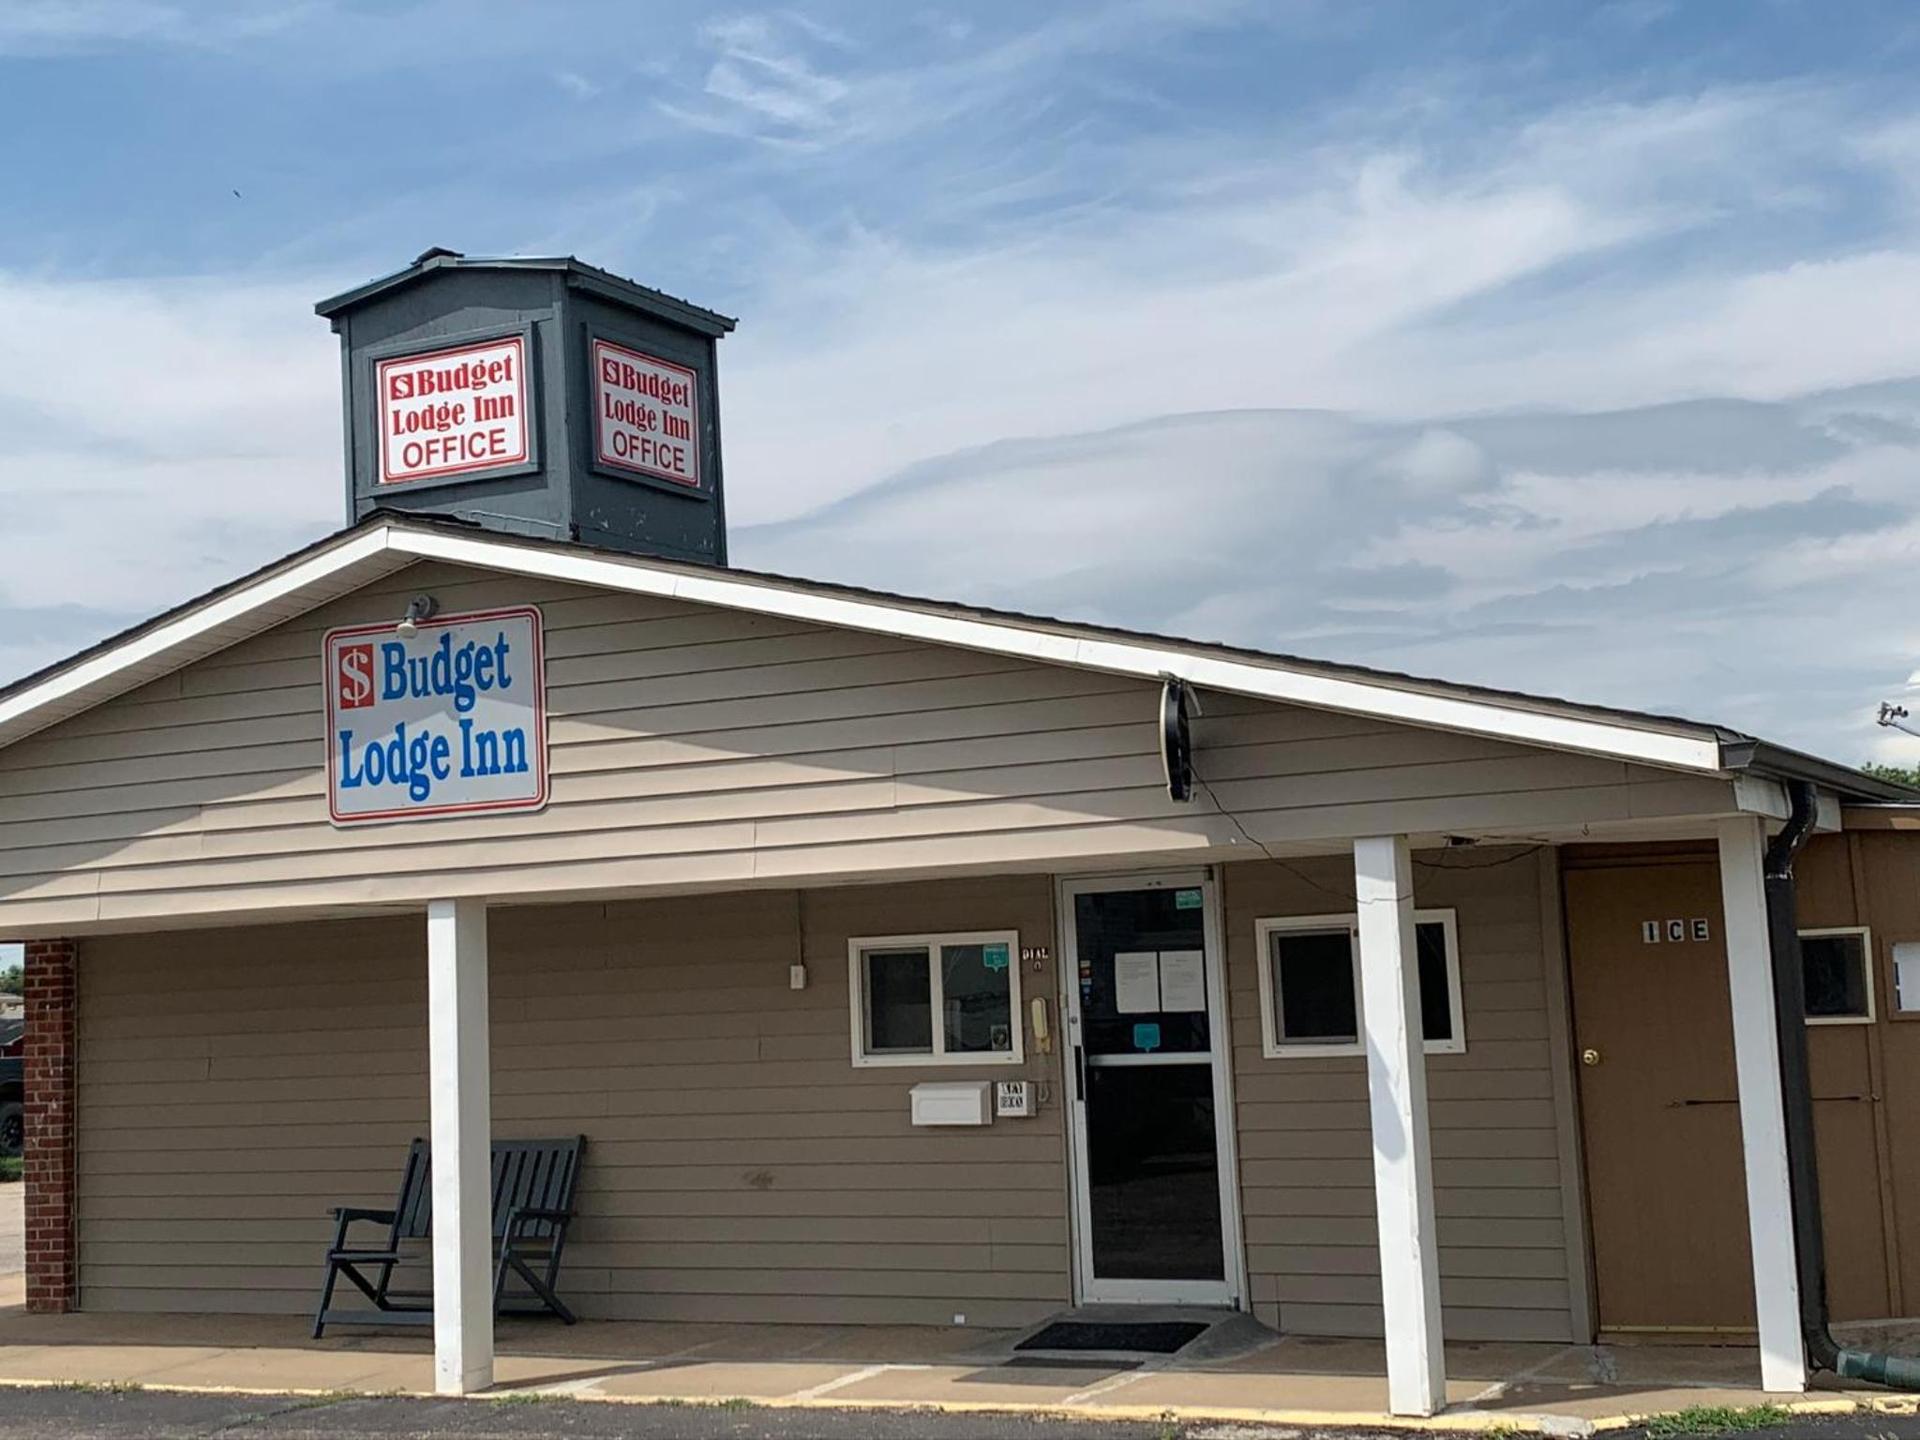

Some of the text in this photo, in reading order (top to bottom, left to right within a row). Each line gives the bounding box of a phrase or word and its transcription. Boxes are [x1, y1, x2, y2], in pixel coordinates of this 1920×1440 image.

[416, 354, 513, 396] Budget
[621, 363, 689, 408] Budget
[392, 394, 515, 436] Lodge Inn
[604, 392, 690, 441] Lodge Inn
[402, 428, 507, 468] OFFICE
[612, 430, 685, 473] OFFICE
[381, 631, 513, 713] Budget
[339, 718, 529, 802] Lodge Inn
[1647, 920, 1708, 941] ICE
[1022, 947, 1049, 960] DIAL
